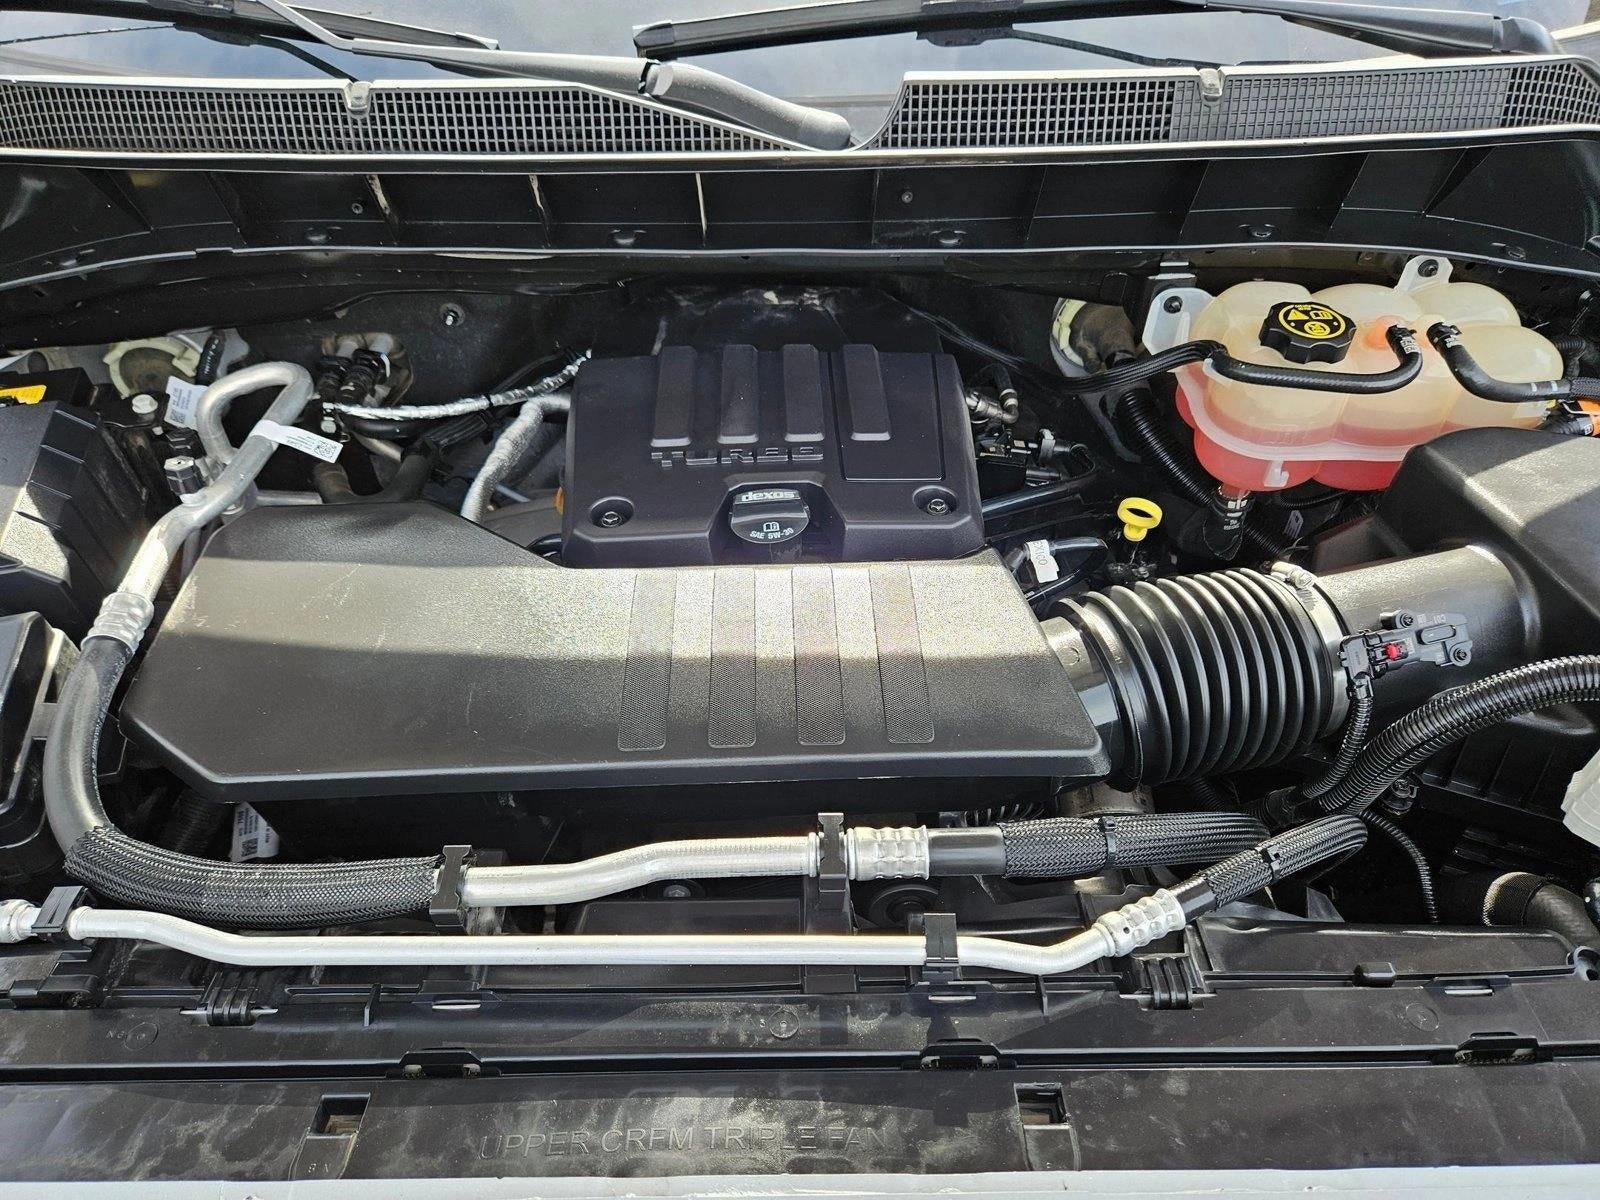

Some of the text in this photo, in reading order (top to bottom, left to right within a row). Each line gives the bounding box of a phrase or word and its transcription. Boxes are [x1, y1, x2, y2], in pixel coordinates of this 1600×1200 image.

[741, 491, 797, 502] dexos
[750, 527, 795, 540] SAE 5W-30
[478, 1126, 887, 1160] UPPER CRFM TRIPLE FAN
